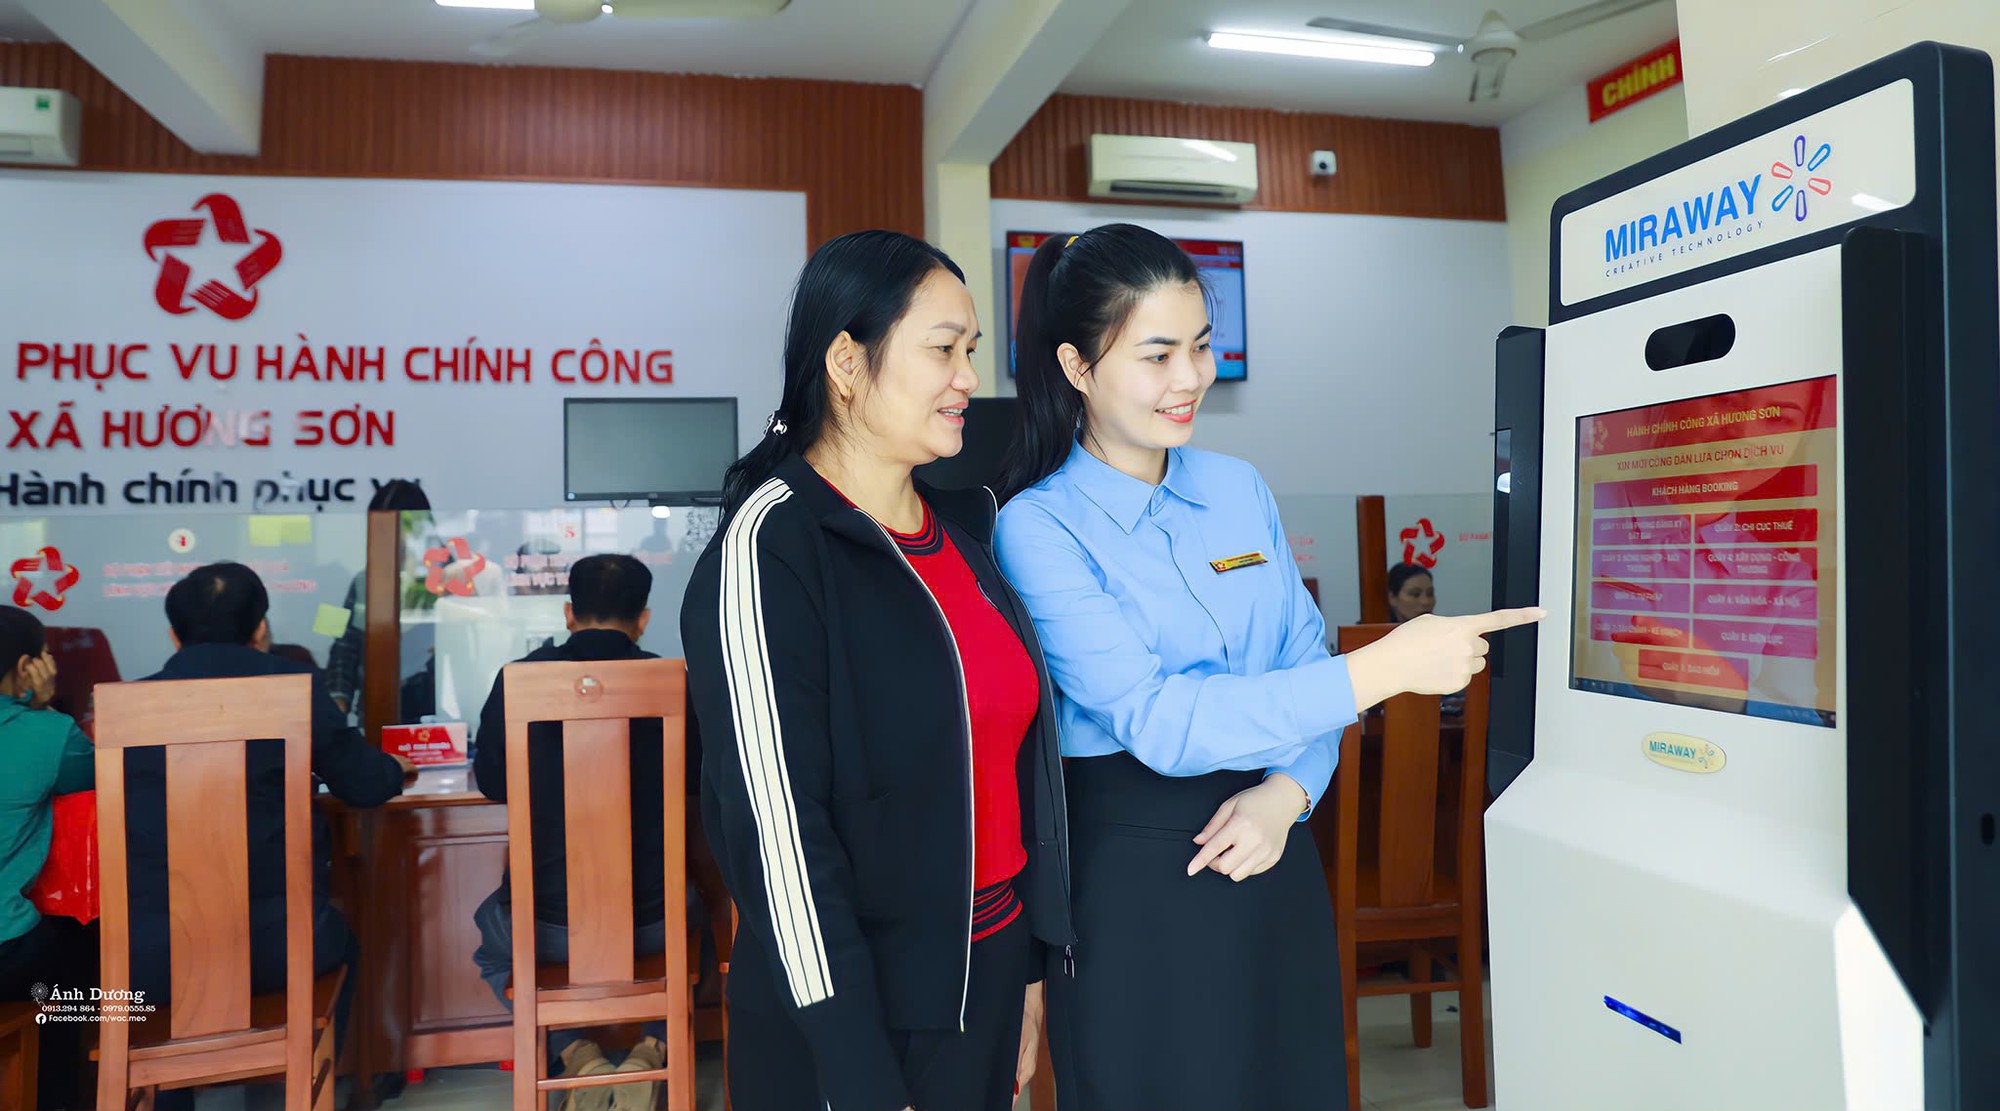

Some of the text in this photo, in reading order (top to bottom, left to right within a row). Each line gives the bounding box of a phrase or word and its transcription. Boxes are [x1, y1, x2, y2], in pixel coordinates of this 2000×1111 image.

[1605, 173, 1763, 263] MIRAWAY
[1605, 220, 1763, 278] CREATIVE TECHNOLOGY
[17, 342, 149, 392] PHỤC
[256, 333, 385, 382] HÀNH
[404, 336, 532, 383] CHÍNH
[551, 338, 673, 384] CÔNG
[8, 401, 82, 449] XÃ
[294, 403, 395, 447] SƠN
[1627, 405, 1781, 438] HÀNH CHÍNH CÔNG XÃ HƯƠNG SƠN
[1617, 461, 1631, 471] XIN
[1650, 454, 1672, 468] CÔNG
[1674, 453, 1693, 466] DÂN
[123, 468, 237, 505] chính
[1651, 480, 1738, 497] KHÁCH HÀNG BOOKING
[1649, 740, 1696, 759] MIRAWAY
